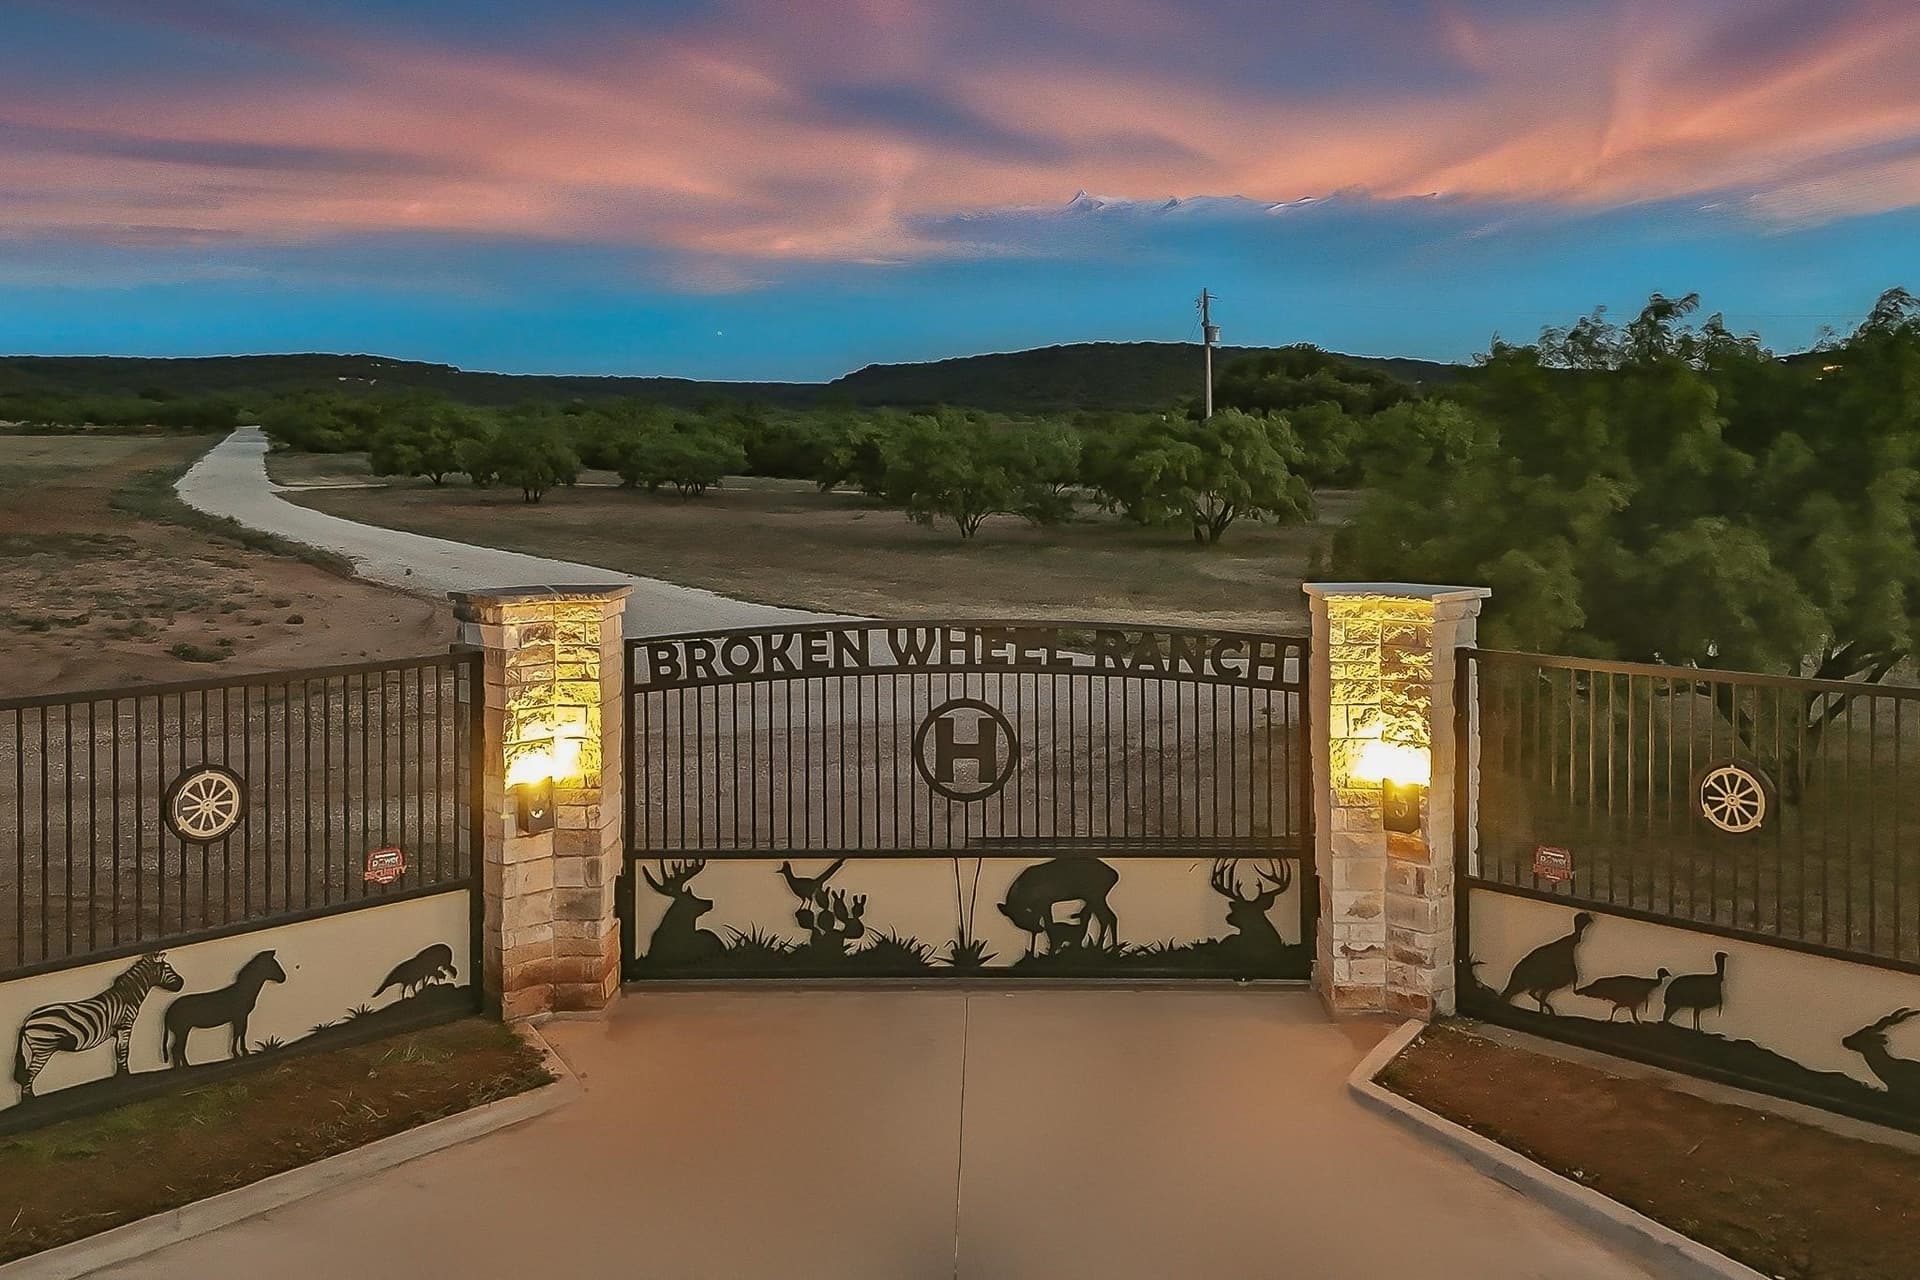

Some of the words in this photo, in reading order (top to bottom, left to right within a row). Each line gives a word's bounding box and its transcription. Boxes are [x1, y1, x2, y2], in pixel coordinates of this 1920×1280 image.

[649, 630, 868, 684] BROKEN
[886, 627, 1073, 667] WHEEL
[1096, 630, 1284, 683] RANCH
[935, 718, 997, 783] H
[364, 865, 407, 881] SECURITY
